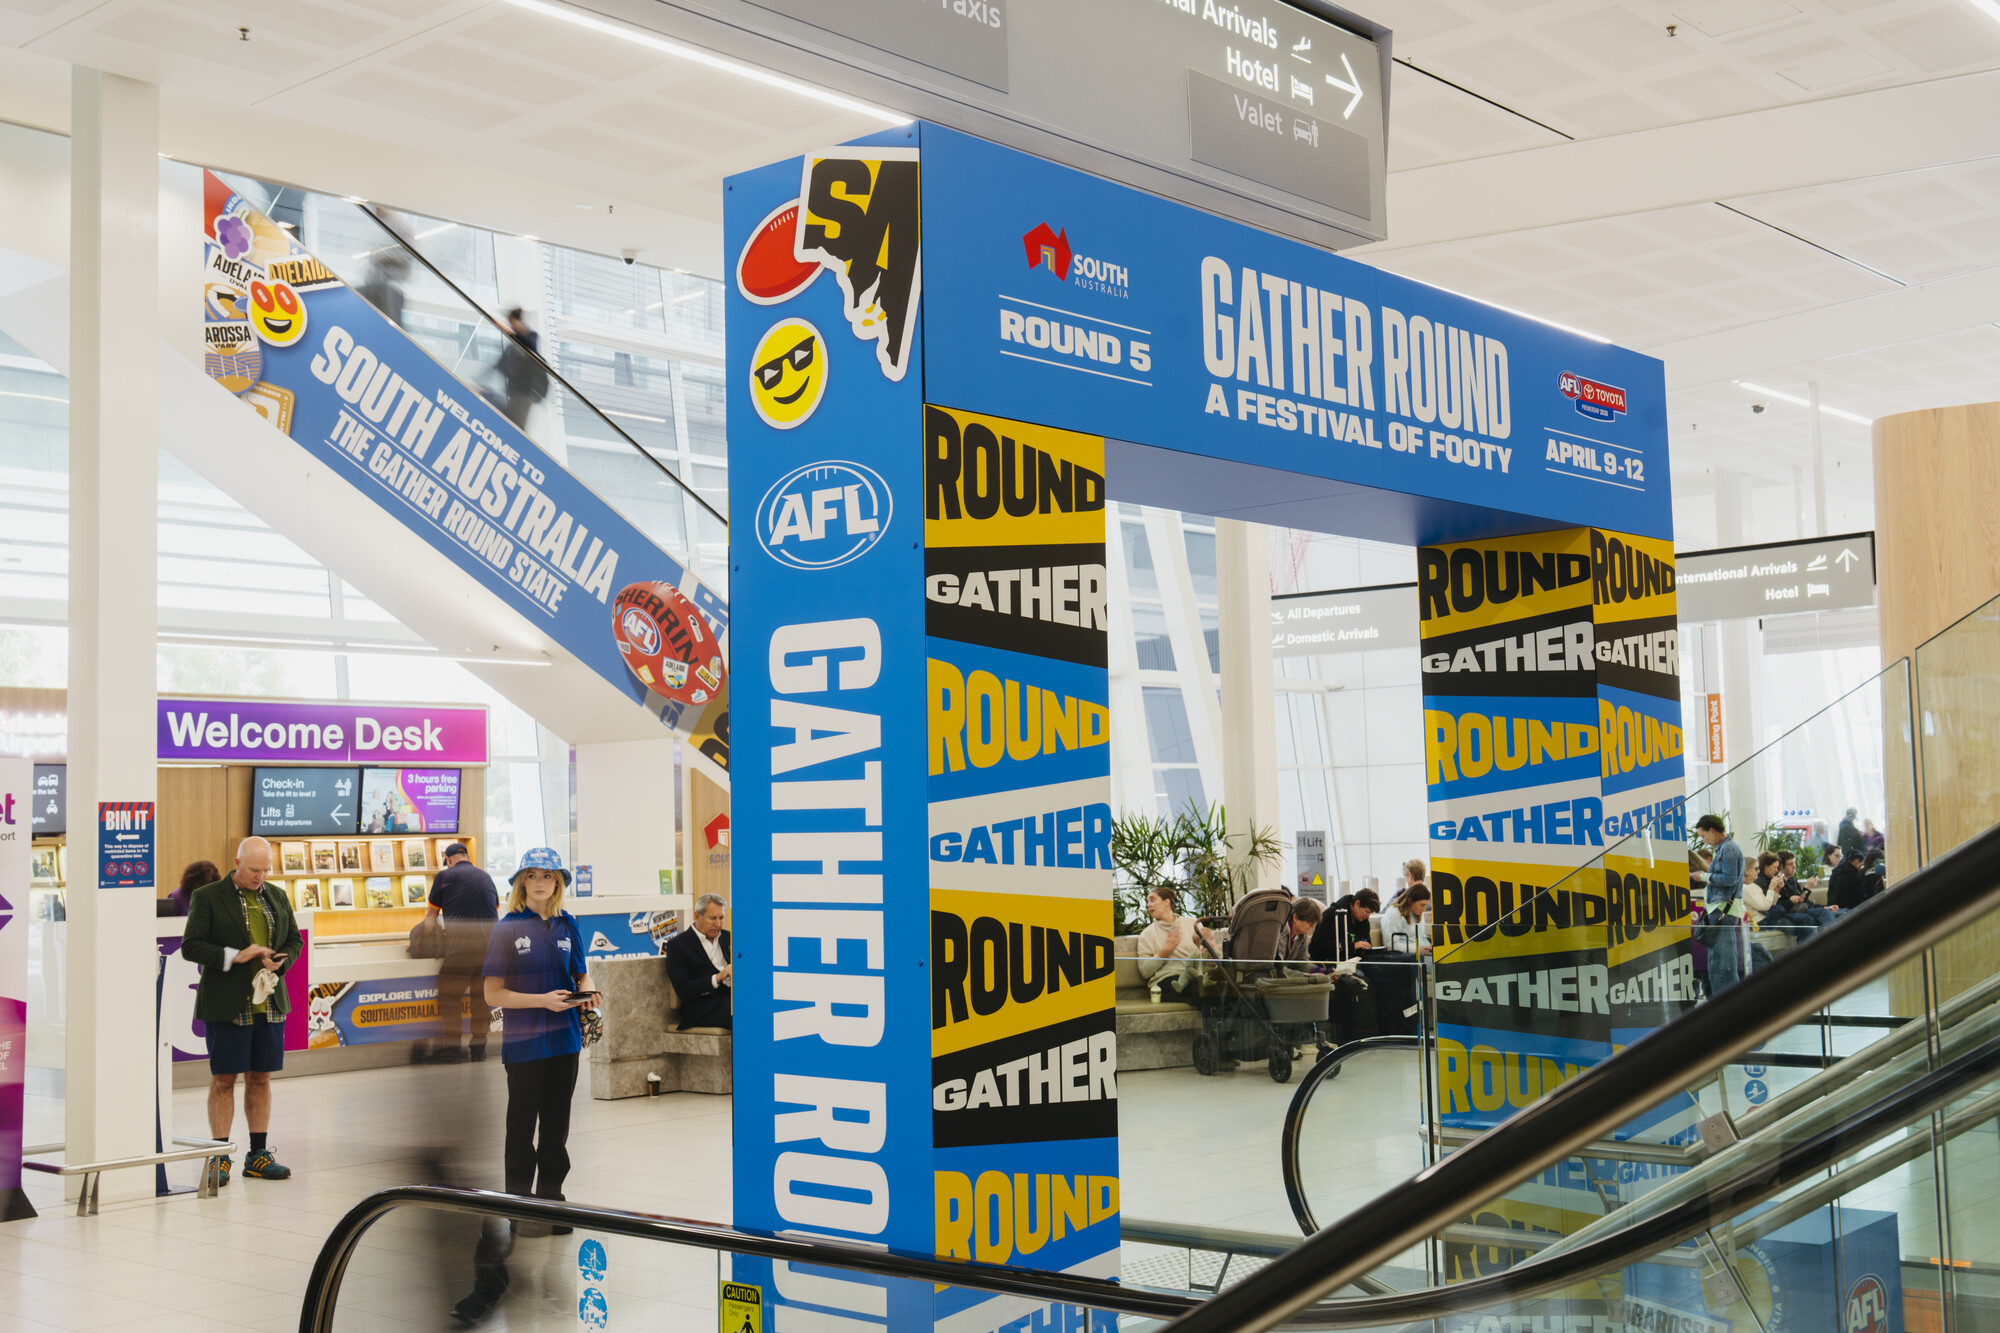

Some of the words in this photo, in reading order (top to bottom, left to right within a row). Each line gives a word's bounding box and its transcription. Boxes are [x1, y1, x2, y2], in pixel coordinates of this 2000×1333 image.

[1202, 0, 1278, 49] Arrivals
[1227, 46, 1279, 93] Hotel
[1234, 94, 1283, 136] Valet
[1073, 253, 1129, 288] SOUTH
[1075, 276, 1129, 299] AUSTRALIA
[1000, 308, 1122, 365] ROUND
[1130, 340, 1152, 372] 5
[1201, 255, 1375, 412] GATHER
[1381, 306, 1511, 439] ROUND
[1560, 376, 1580, 394] AFL
[1595, 388, 1624, 407] TOYOTA
[436, 388, 518, 466] WELCOME
[521, 458, 545, 486] TO
[1205, 383, 1230, 418] A
[1237, 389, 1382, 449] FESTIVAL
[1388, 421, 1423, 454] OF
[1429, 430, 1513, 474] FOOTY
[310, 325, 446, 461] SOUTH
[431, 426, 620, 606] AUSTRALIA
[925, 403, 1105, 520] ROUND
[1545, 438, 1602, 472] APRIL
[1603, 452, 1645, 482] 9-12
[329, 409, 376, 463] THE
[368, 441, 449, 521] GATHER
[442, 499, 514, 571] ROUND
[508, 551, 568, 613] STATE
[768, 483, 880, 546] AFL
[1417, 547, 1592, 621] ROUND
[1591, 528, 1676, 605] ROUND
[1676, 566, 1748, 585] nternational
[1750, 561, 1798, 577] Arrivals
[926, 563, 1108, 632] GATHER
[1287, 608, 1302, 620] All
[1303, 604, 1361, 619] Departures
[1765, 585, 1799, 600] Hotel
[623, 612, 656, 655] AFL
[1287, 630, 1335, 645] Domestic
[1337, 626, 1379, 641] Arrivals
[1421, 621, 1596, 673] GATHER
[1595, 629, 1679, 677] GATHER
[167, 711, 345, 750] Welcome
[355, 716, 444, 751] Desk
[926, 656, 1110, 777] ROUND
[1709, 699, 1719, 723] Point
[1424, 709, 1599, 785] ROUND
[1598, 698, 1684, 779] ROUND
[1711, 724, 1721, 760] Meeting
[262, 778, 305, 789] Check-in
[407, 774, 414, 784] 3
[415, 774, 440, 784] hours
[441, 774, 458, 784] free
[425, 784, 458, 794] parking
[105, 810, 131, 831] BIN
[135, 810, 148, 830] IT
[261, 807, 281, 818] Lifts
[769, 617, 886, 1048] GATHER
[930, 802, 1113, 870] GATHER
[1429, 796, 1605, 847] GATHER
[1604, 795, 1687, 842] GATHER
[1307, 837, 1323, 848] Lift
[1431, 870, 1607, 947] ROUND
[1606, 868, 1691, 949] ROUND
[931, 909, 1115, 1031] ROUND
[1434, 963, 1610, 1016] GATHER
[1609, 952, 1695, 1005] GATHER
[358, 991, 412, 1003] EXPLORE
[414, 988, 439, 999] WHA
[933, 1030, 1118, 1112] GATHER
[934, 1169, 1120, 1270] ROUND
[725, 1285, 758, 1303] CAUTION
[728, 1301, 755, 1313] Passengers
[728, 1309, 739, 1318] Only
[1850, 1286, 1885, 1332] AFL
